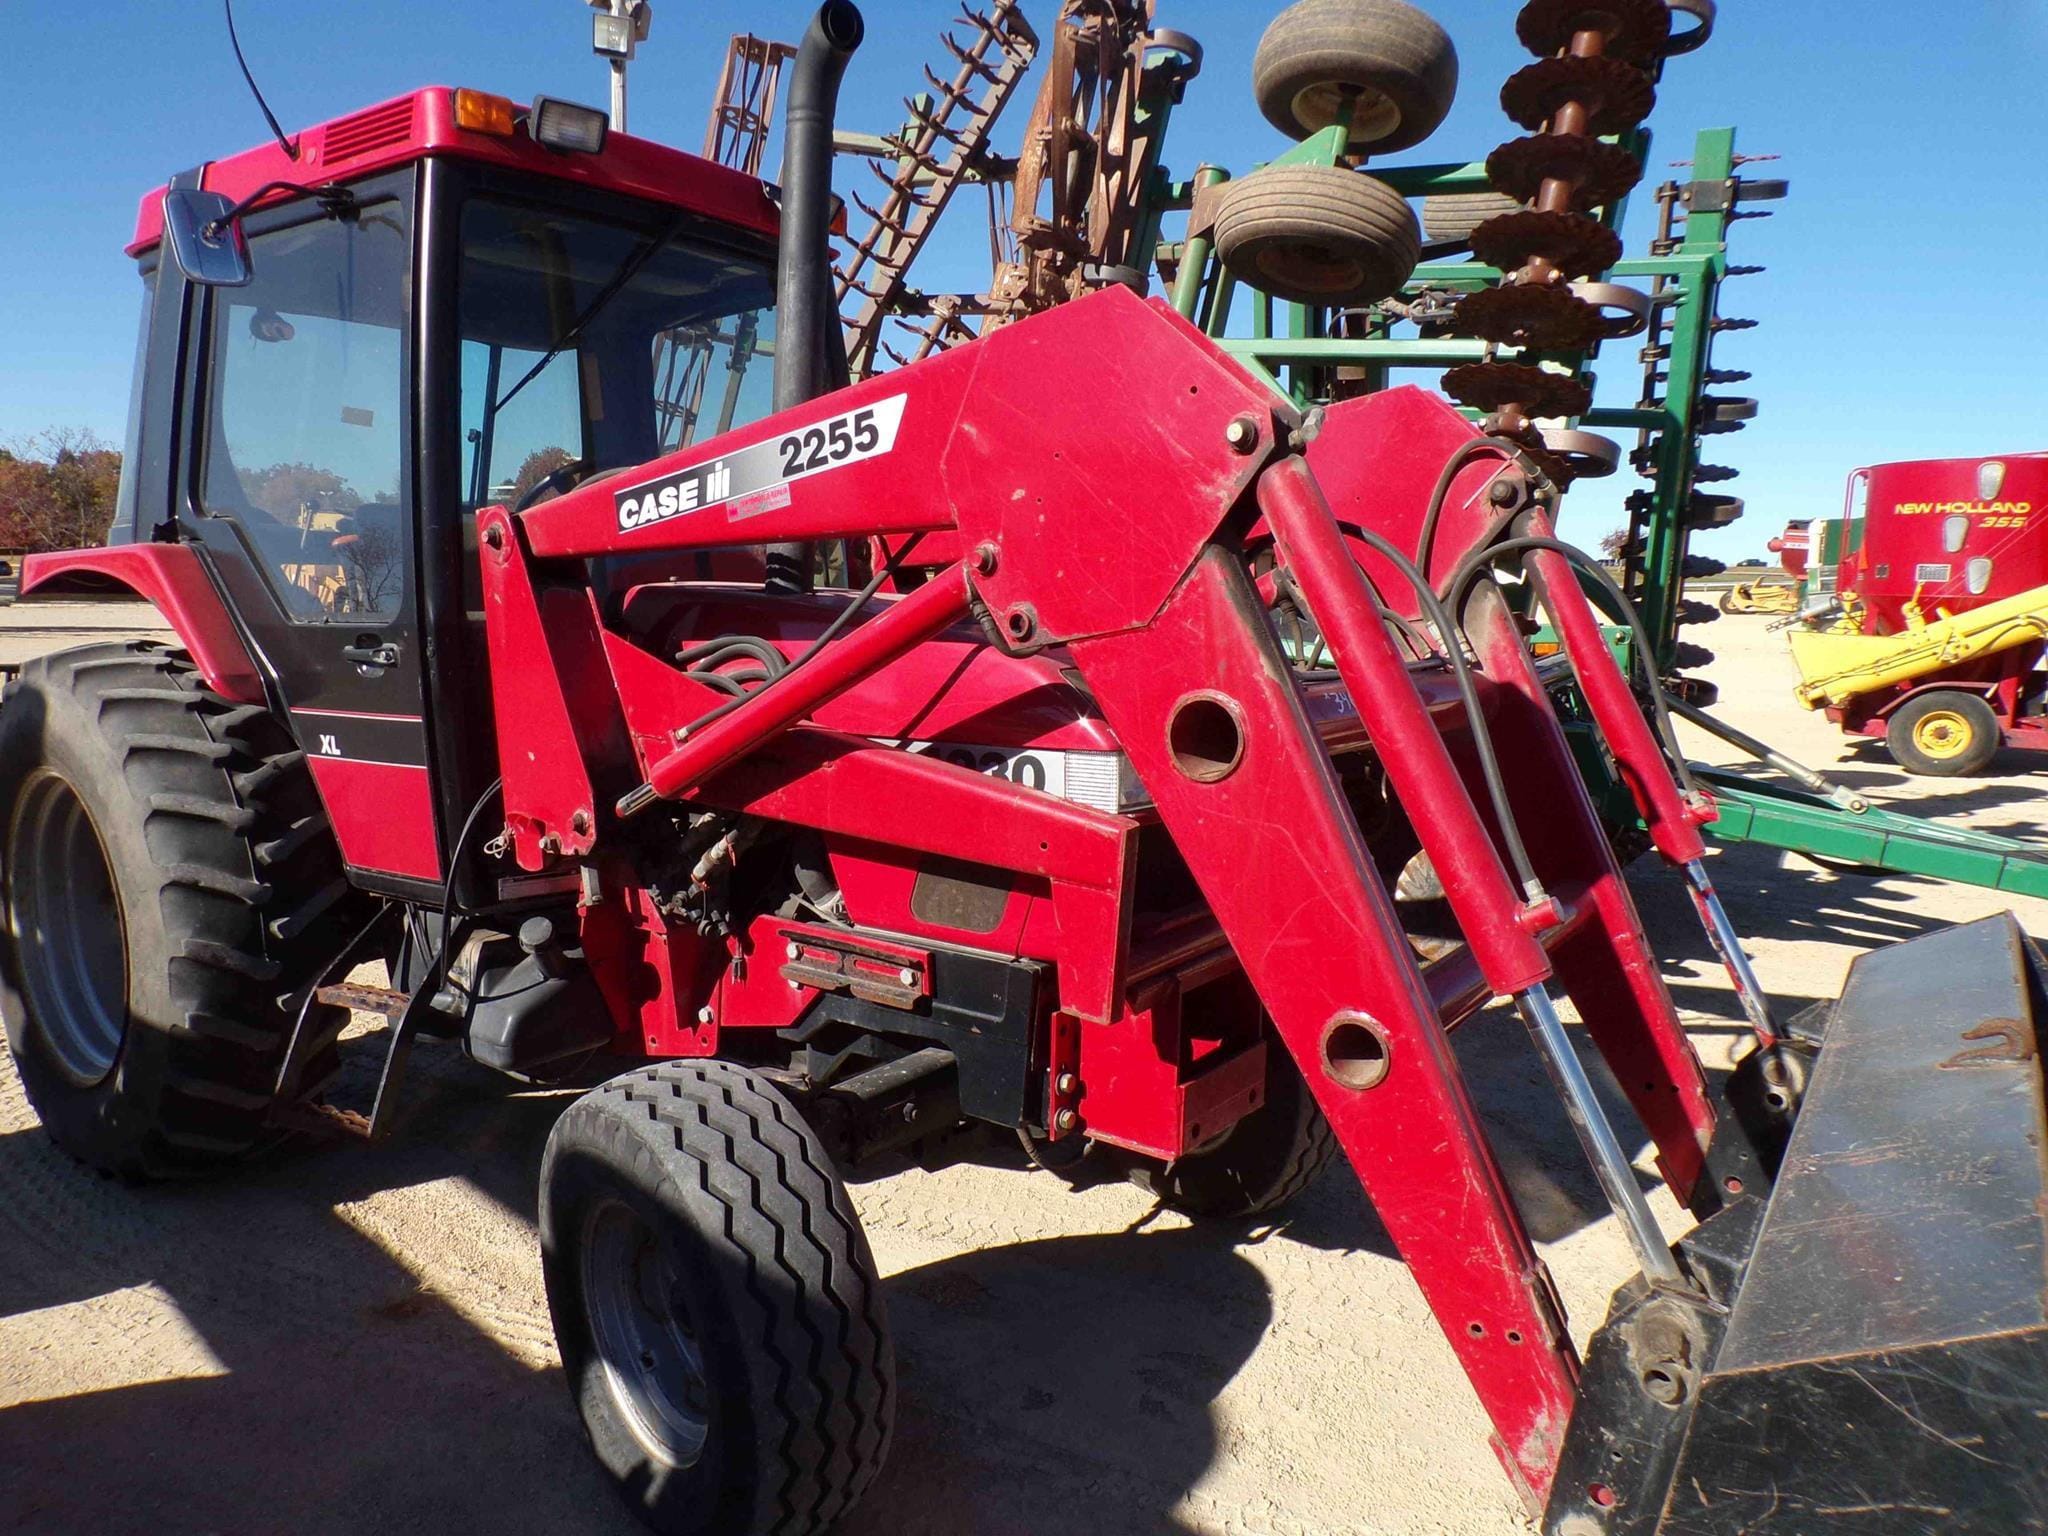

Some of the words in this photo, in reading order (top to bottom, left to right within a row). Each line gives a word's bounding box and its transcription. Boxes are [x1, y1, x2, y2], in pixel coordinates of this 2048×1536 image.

[619, 478, 699, 529] CASE
[781, 411, 879, 477] 2255
[1893, 502, 1933, 515] NEW
[1935, 501, 2032, 514] HOLLAND
[1978, 517, 2027, 528] 355
[320, 734, 341, 755] XL
